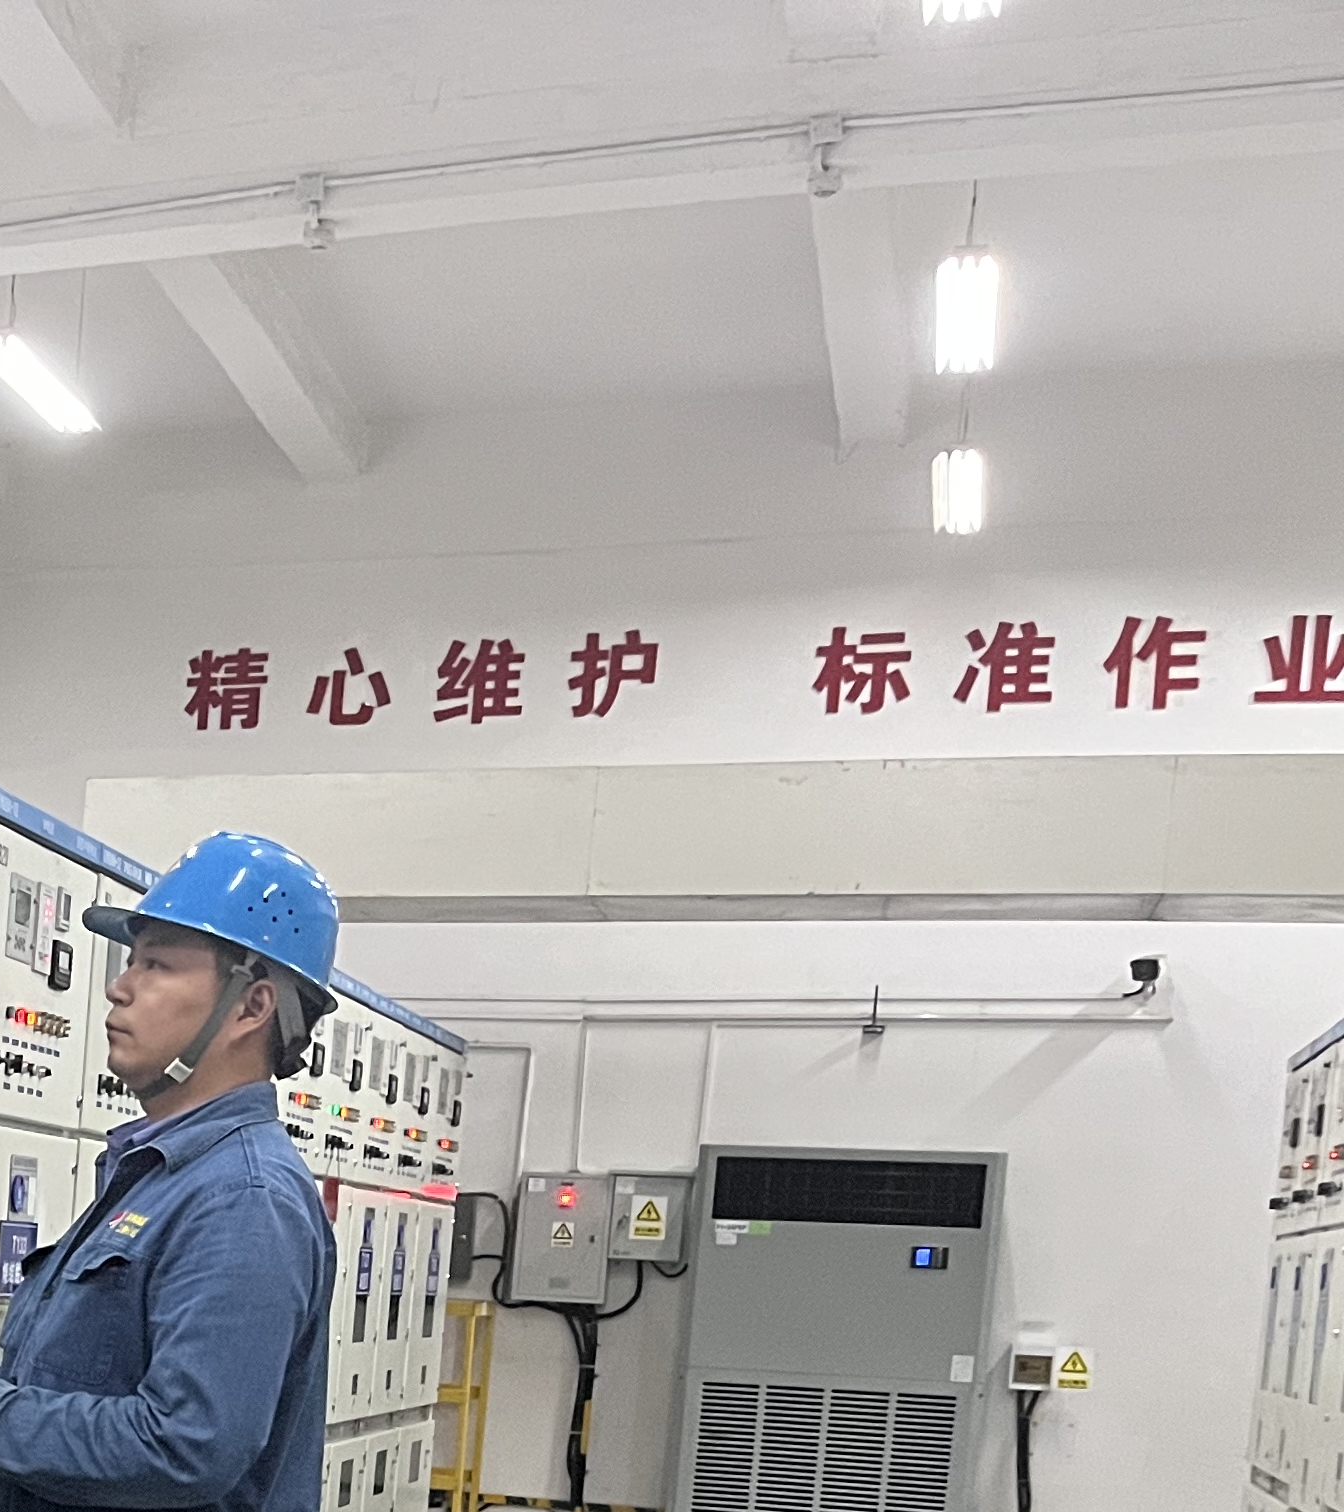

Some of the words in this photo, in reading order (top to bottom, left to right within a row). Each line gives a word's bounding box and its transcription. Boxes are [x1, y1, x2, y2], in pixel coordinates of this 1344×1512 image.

[183, 628, 660, 732] 精心维护
[812, 614, 1344, 716] 标准作业
